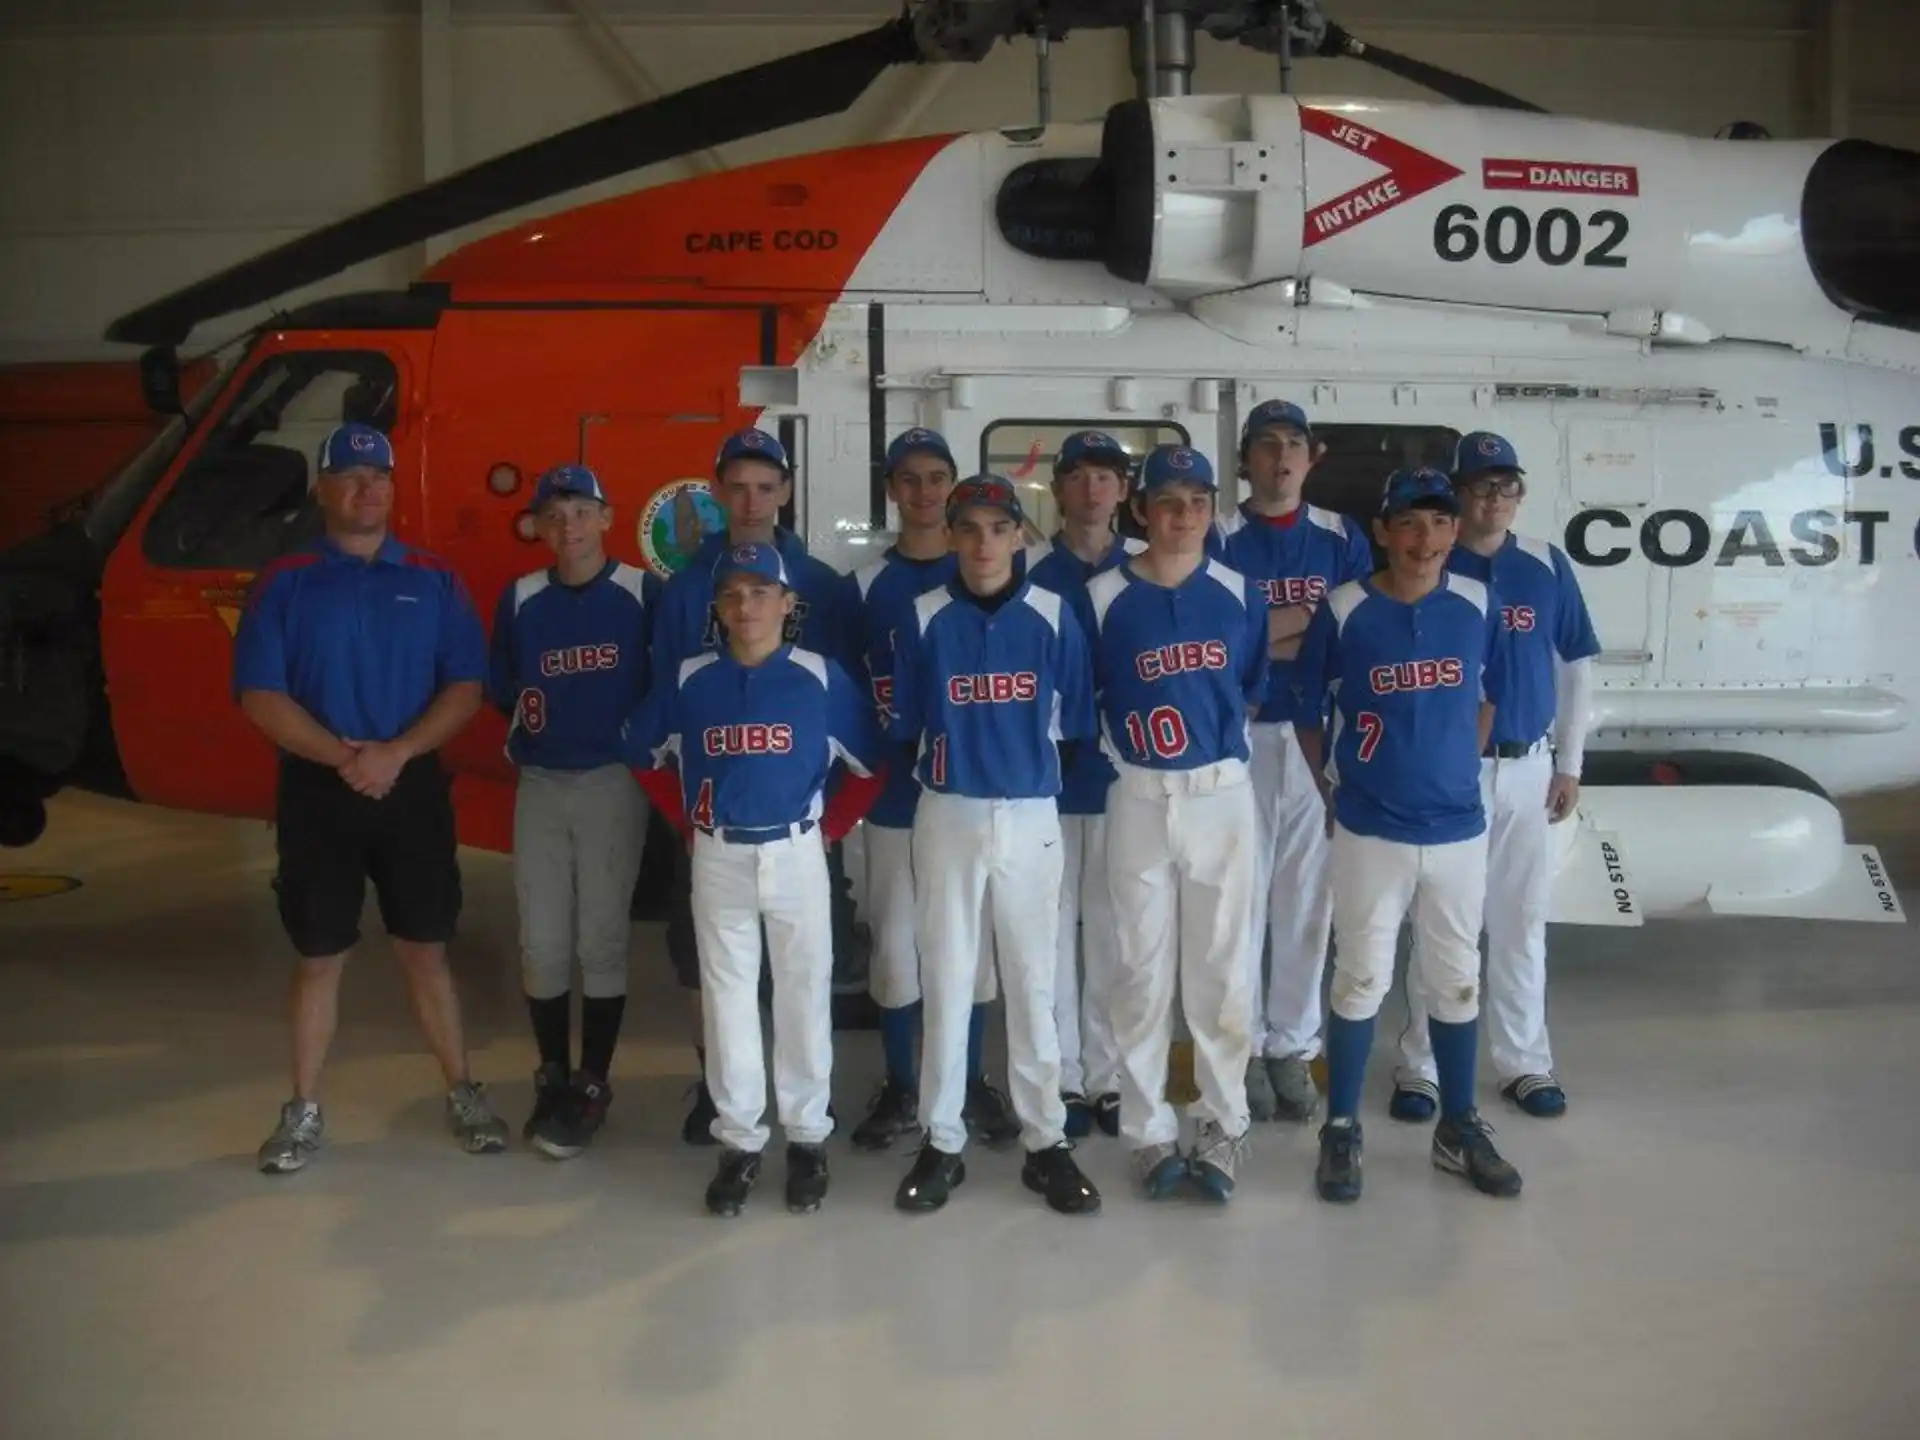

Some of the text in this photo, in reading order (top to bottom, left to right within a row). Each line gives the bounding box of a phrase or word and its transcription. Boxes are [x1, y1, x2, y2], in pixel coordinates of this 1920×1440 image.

[1331, 124, 1377, 151] JET
[1529, 167, 1629, 190] DANGER
[1314, 180, 1400, 233] INTAKE
[685, 229, 838, 253] CAPE COD
[1433, 203, 1629, 268] 6002
[1564, 509, 1889, 567] COAST
[1501, 606, 1535, 632] BS
[541, 643, 619, 677] CUBS
[1136, 640, 1228, 681] CUBS
[1370, 657, 1464, 695] CUBS
[520, 687, 546, 733] 8
[948, 671, 1038, 705] CUBS
[704, 723, 794, 757] CUBS
[1125, 705, 1189, 762] 10
[1357, 711, 1383, 763] 7
[932, 734, 946, 786] 1
[692, 779, 714, 829] 4
[1601, 842, 1633, 913] NO STEP
[1862, 853, 1897, 914] NO STEP
